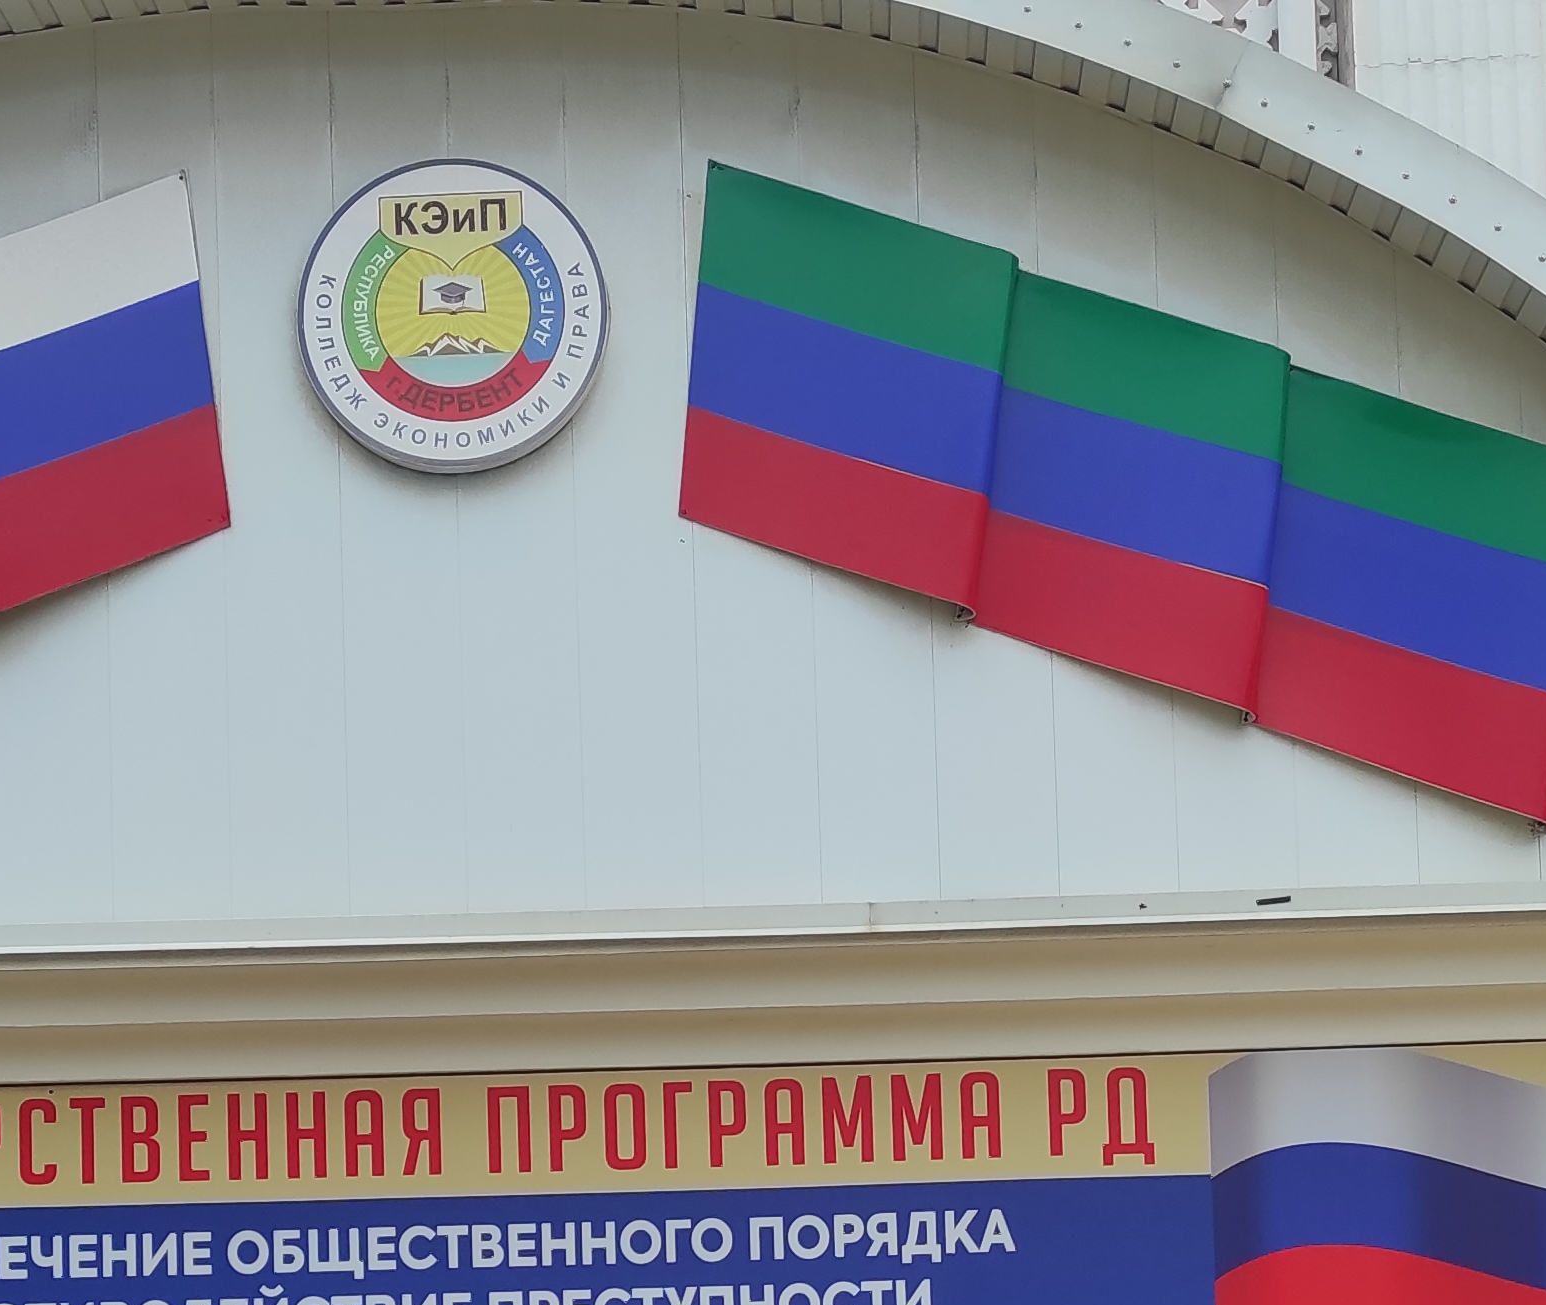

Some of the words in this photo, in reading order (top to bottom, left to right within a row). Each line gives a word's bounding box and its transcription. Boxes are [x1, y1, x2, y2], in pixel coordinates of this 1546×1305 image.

[394, 198, 507, 236] КЭиП
[315, 273, 369, 411] КОЛЛЕДЖ
[373, 396, 552, 450] ЭКОНОМИКИ
[551, 374, 571, 389] И
[566, 261, 591, 360] ПРАВА
[352, 244, 396, 362] РЕСПУБЛИКА
[513, 242, 555, 347] ДАГЕСТАН
[486, 1069, 1003, 1174] ПРОГРАММА
[1047, 1066, 1157, 1167] РД
[227, 1217, 734, 1280] ОБЩЕСТВЕННОГО
[749, 1208, 1016, 1264] ПОРЯДКА
